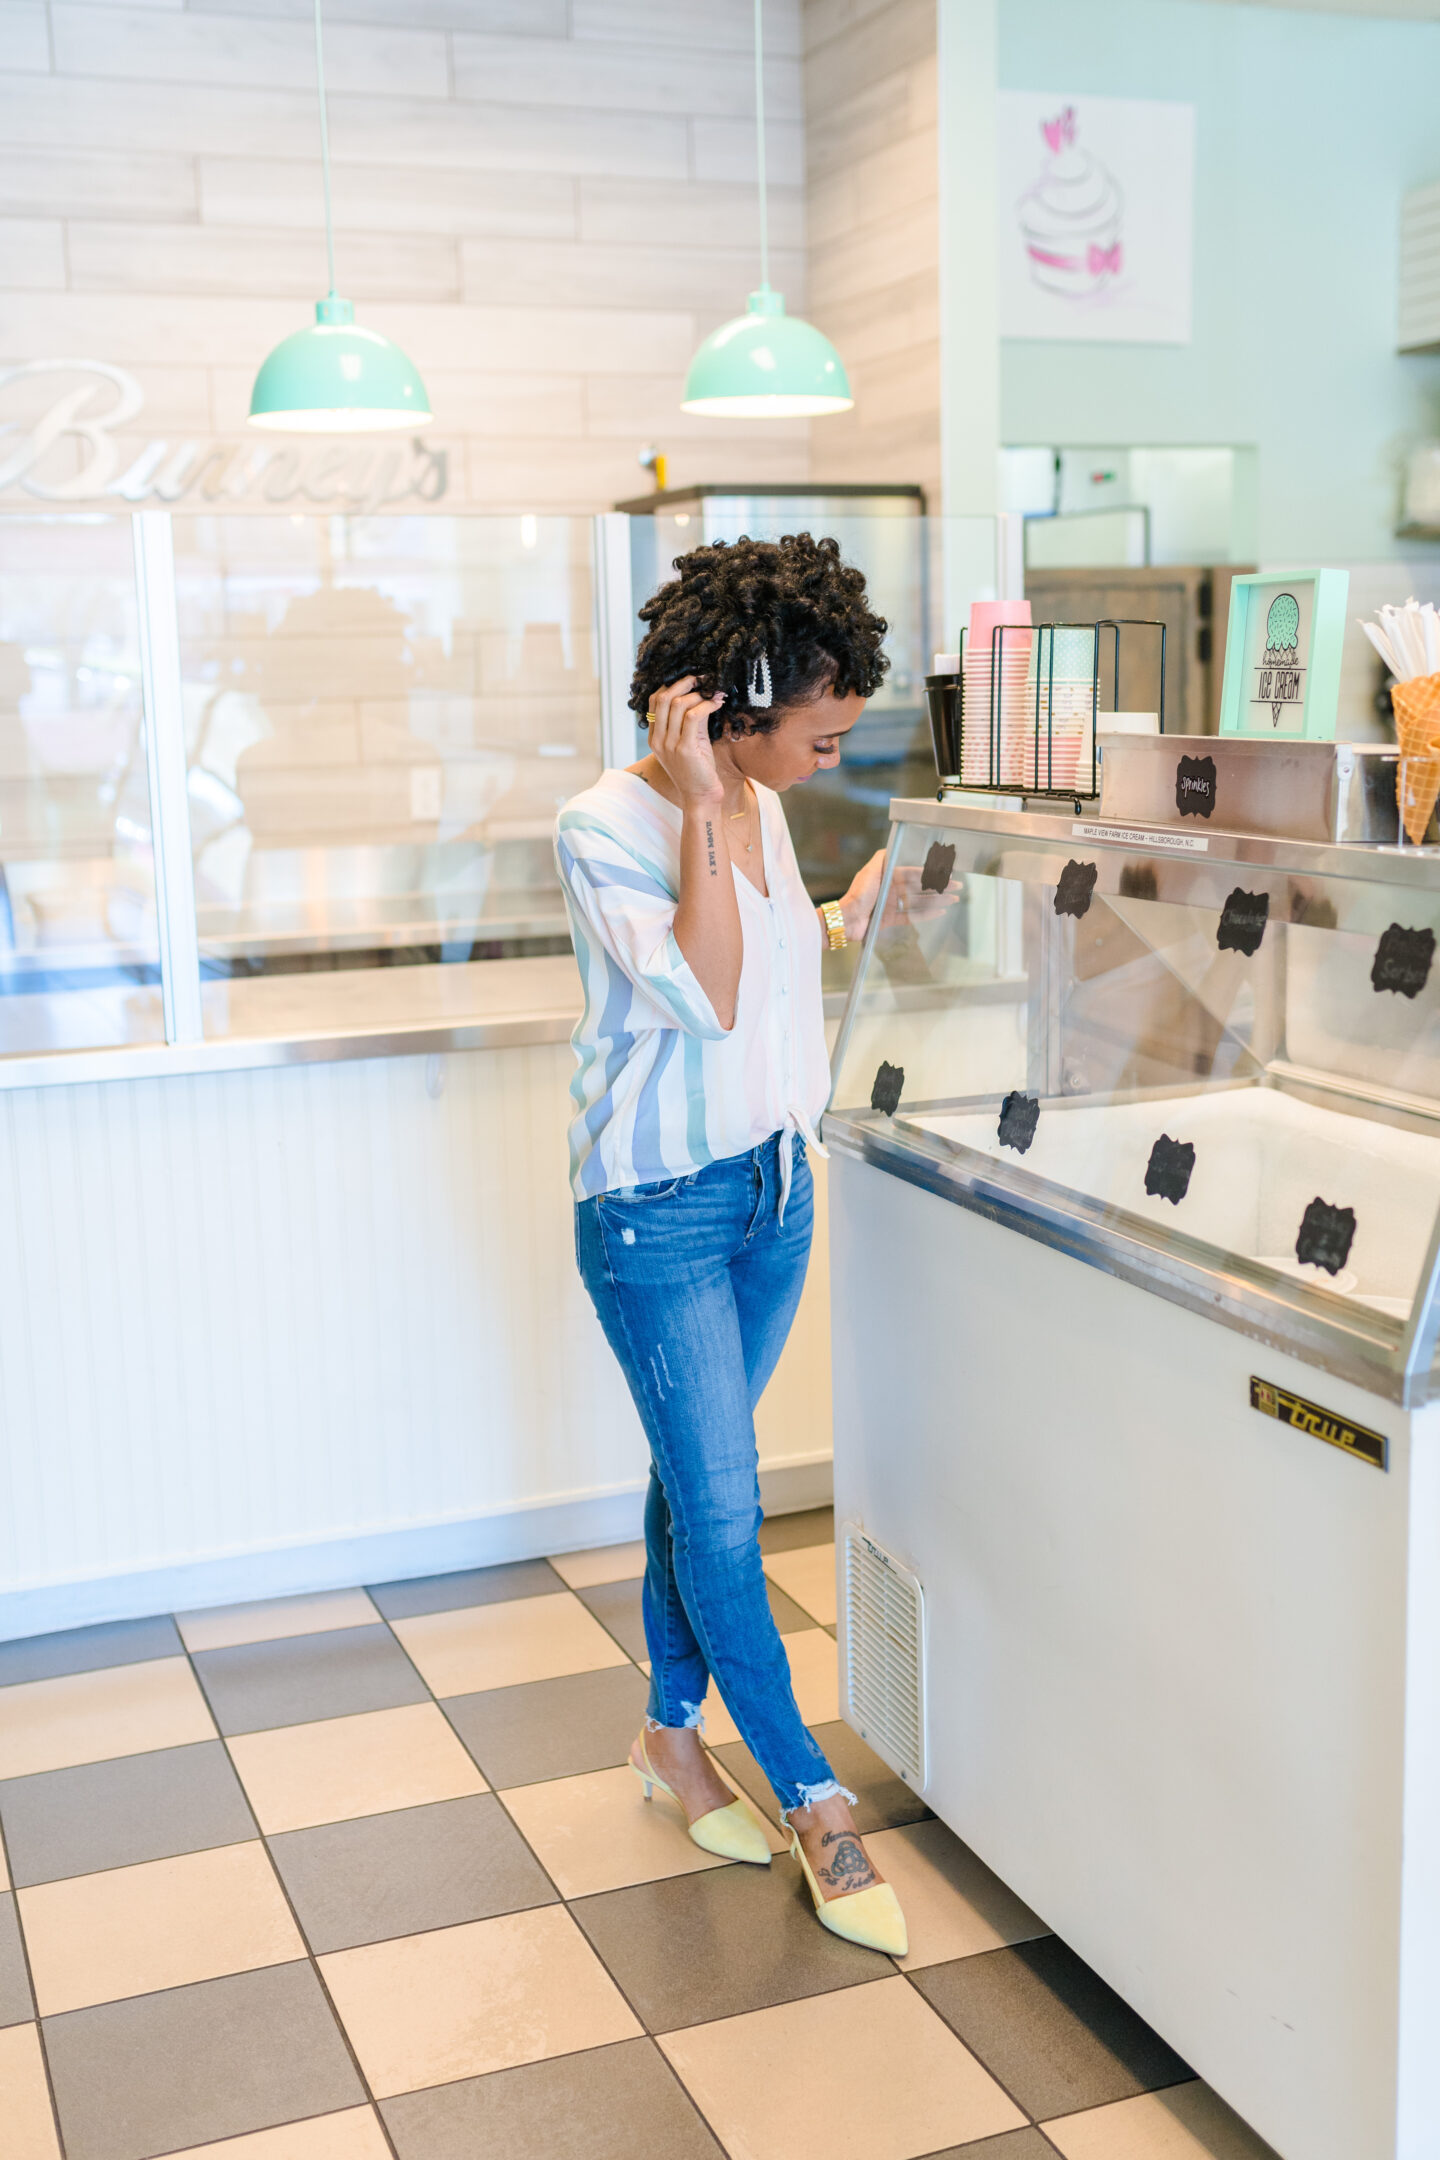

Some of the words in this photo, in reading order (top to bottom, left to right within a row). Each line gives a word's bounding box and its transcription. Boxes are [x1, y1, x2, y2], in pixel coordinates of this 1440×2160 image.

[1263, 650, 1299, 667] homemade
[1083, 827, 1097, 836] MAPLE
[1098, 829, 1109, 837] VIEW
[1109, 830, 1121, 838] FARM
[1121, 831, 1129, 840] ICE
[1129, 832, 1145, 841] CREAM
